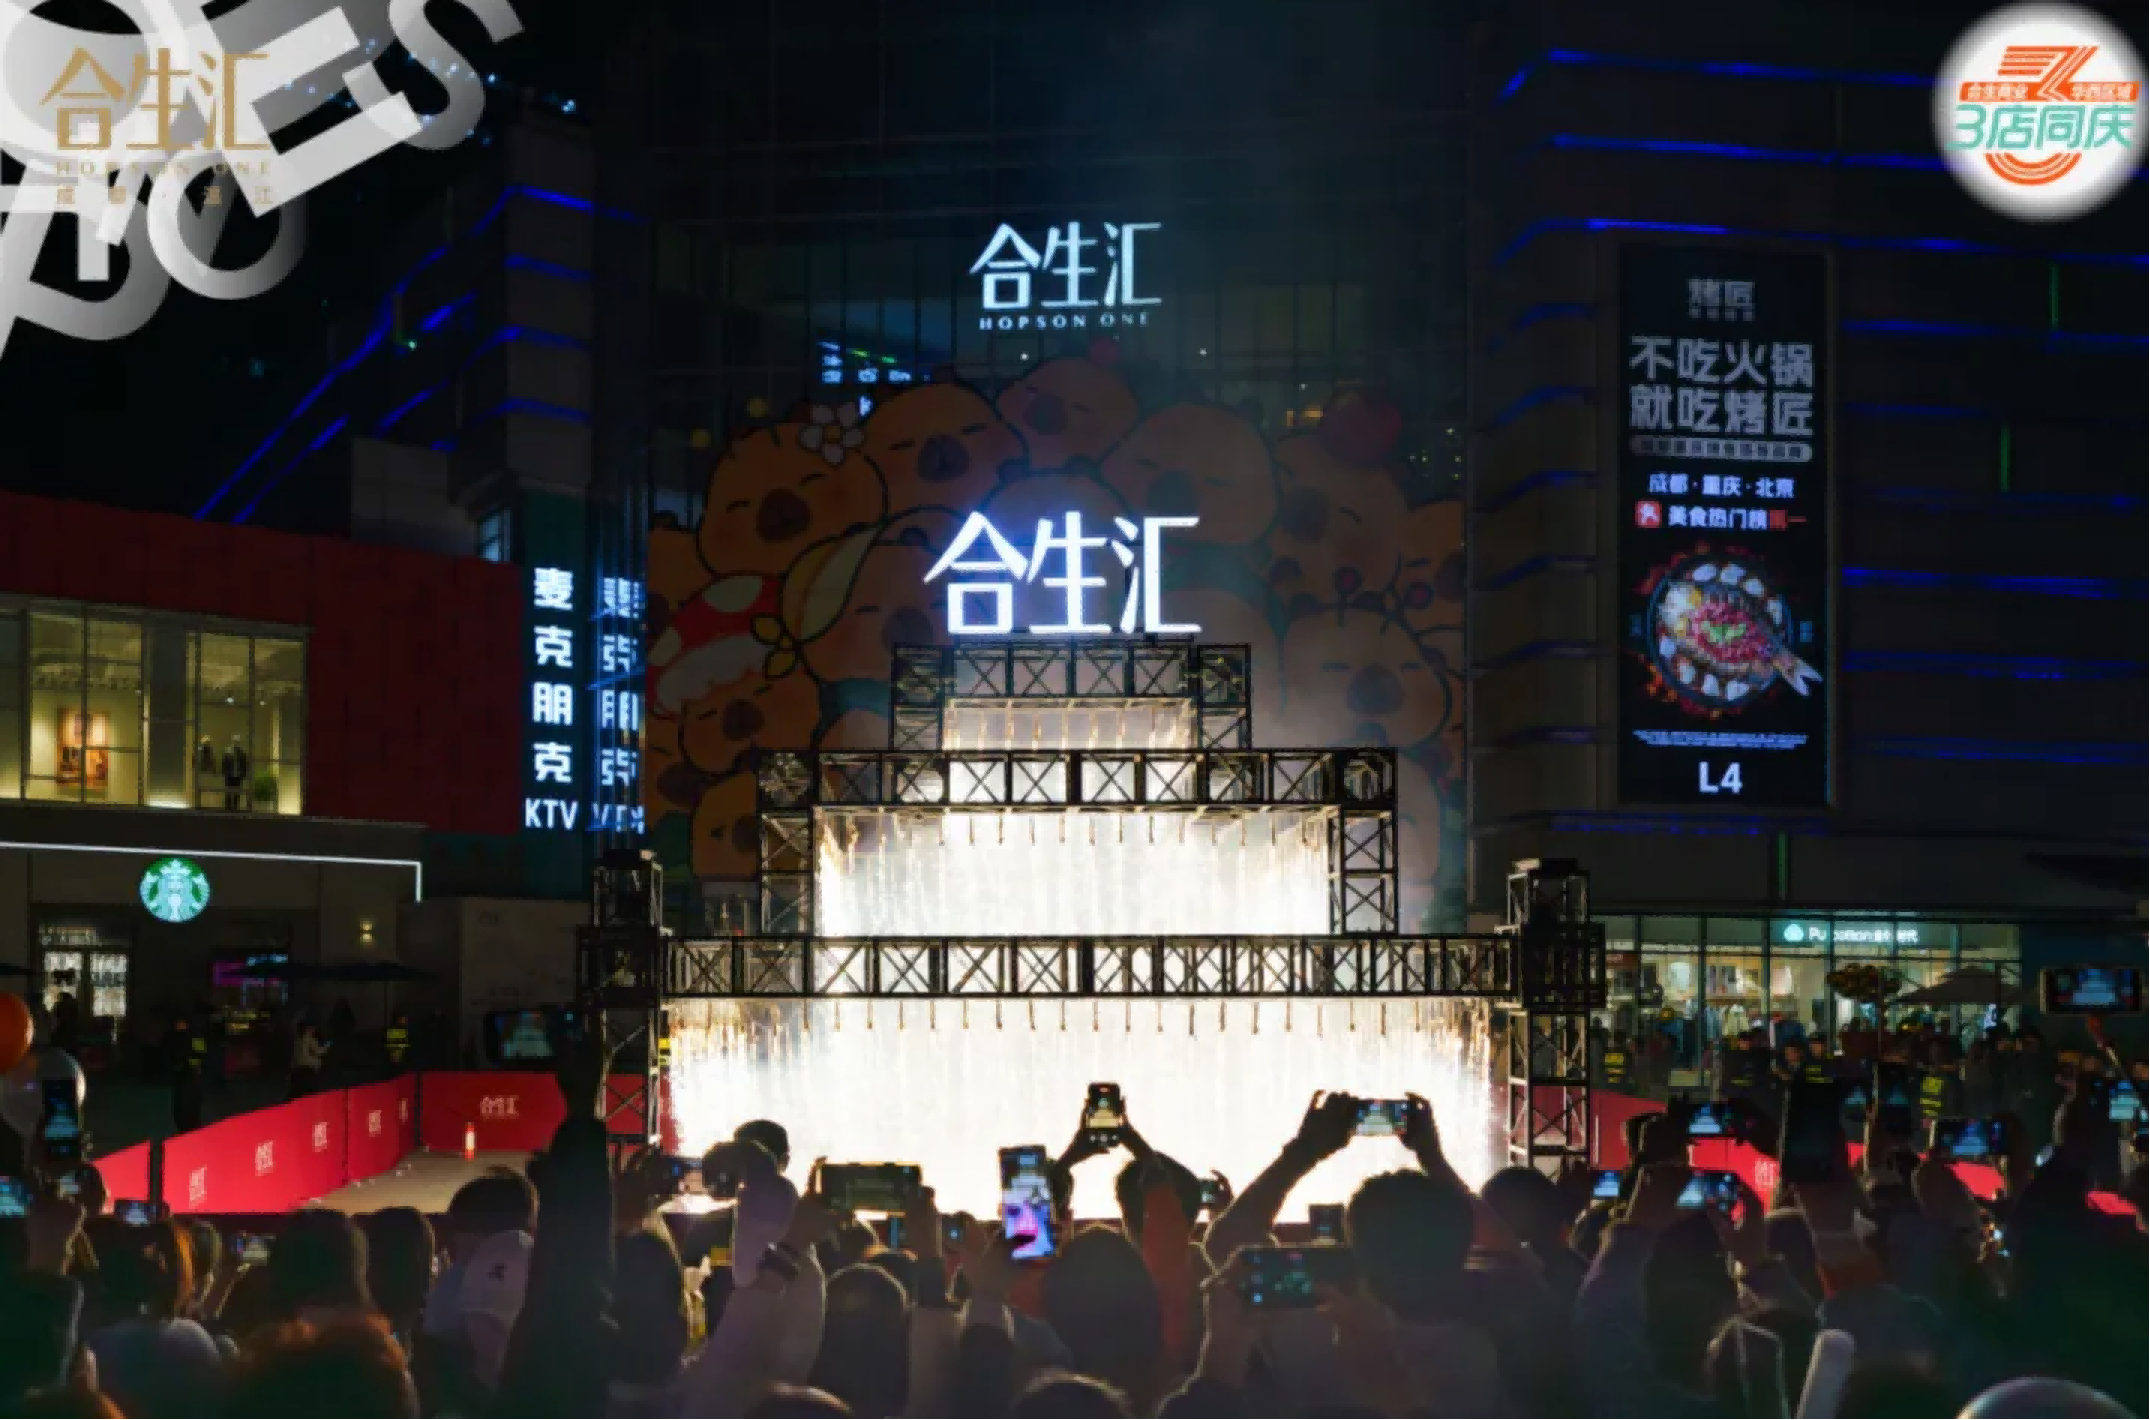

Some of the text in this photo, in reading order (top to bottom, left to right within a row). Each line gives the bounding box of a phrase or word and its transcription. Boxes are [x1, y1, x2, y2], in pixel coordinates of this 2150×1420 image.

[968, 221, 1162, 310] 合生汇
[979, 311, 1149, 330] HOPSON ONE
[1629, 335, 1814, 388] 不吃火锅
[1629, 384, 1814, 436] 就吃烤匠
[922, 511, 1202, 634] 合生汇
[533, 567, 573, 785] 麦克朋克
[1698, 761, 1744, 795] L4
[525, 798, 579, 831] KTV
